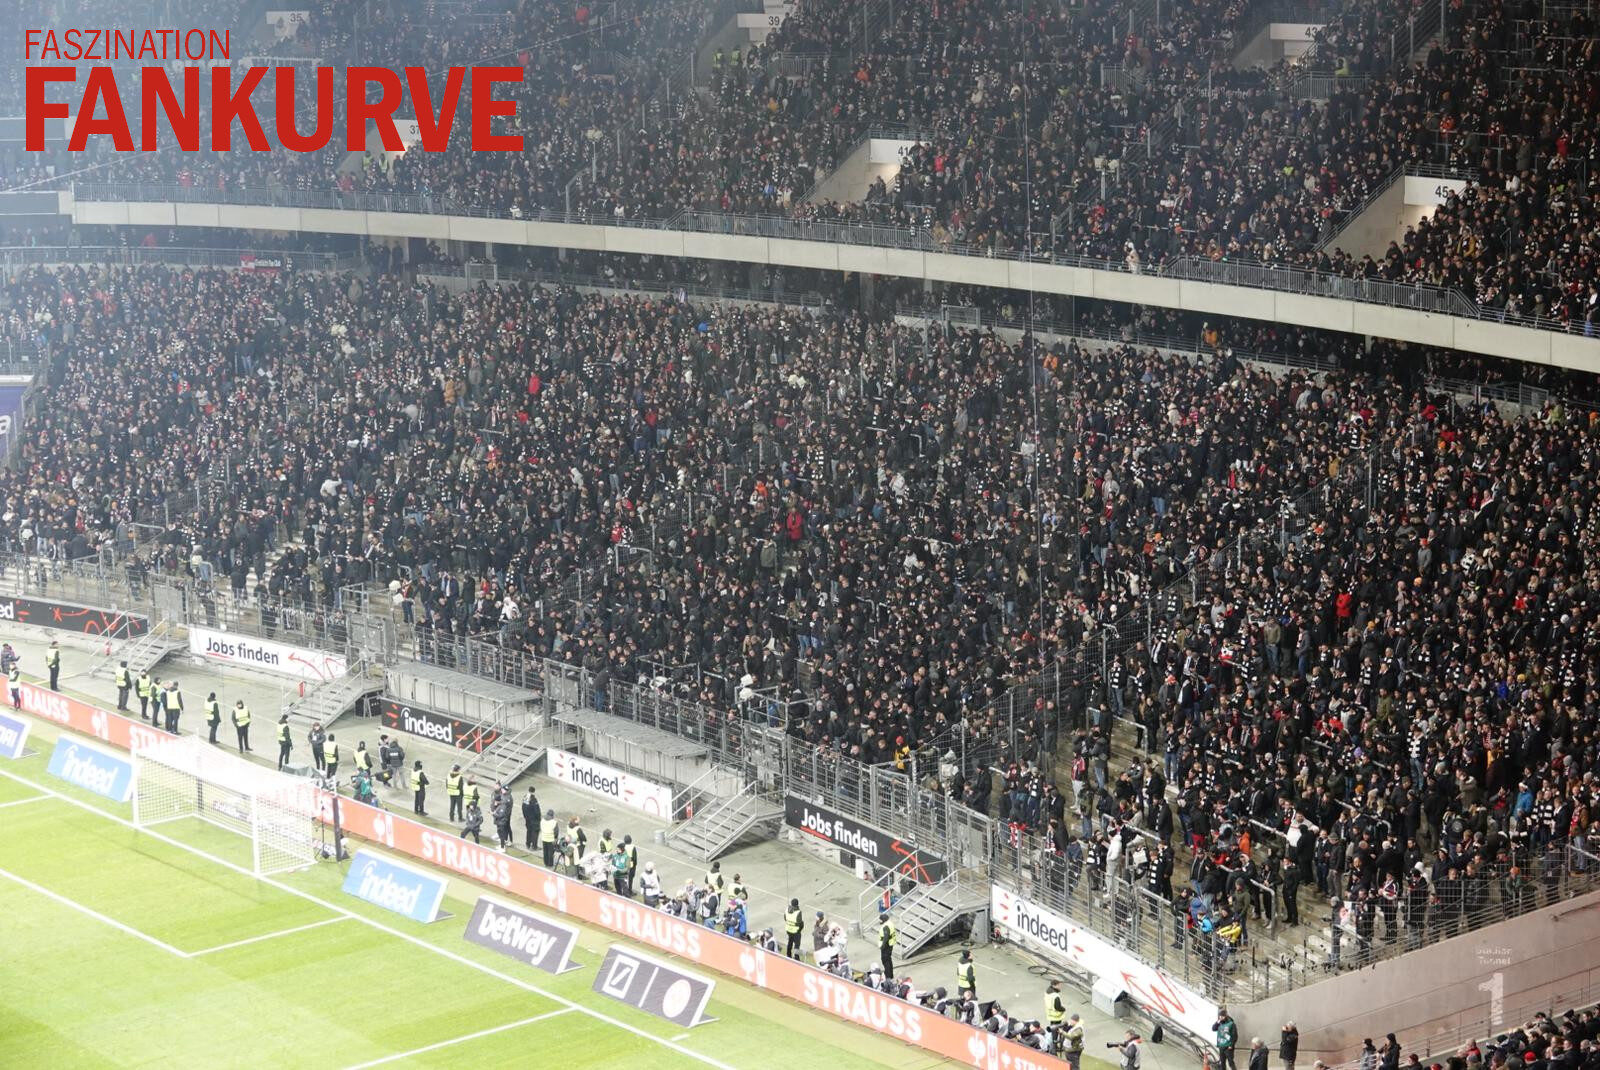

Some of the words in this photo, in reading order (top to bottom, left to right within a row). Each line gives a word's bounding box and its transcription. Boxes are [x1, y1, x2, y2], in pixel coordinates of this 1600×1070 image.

[768, 15, 780, 26] 39
[897, 146, 909, 157] 41
[1435, 186, 1448, 198] 45
[206, 638, 234, 656] Jobs
[235, 643, 279, 665] finden
[401, 707, 453, 743] indeed
[61, 746, 119, 795] indeed
[569, 758, 619, 797] indeed
[800, 808, 832, 836] Jobs
[833, 821, 878, 857] finden
[421, 831, 511, 887] STRAUSS
[359, 861, 423, 914] indeed
[478, 904, 558, 966] betway
[599, 897, 702, 958] STRAUSS
[1016, 903, 1068, 953] indeed
[802, 971, 923, 1042] STRAUSS
[1478, 972, 1503, 1026] 1
